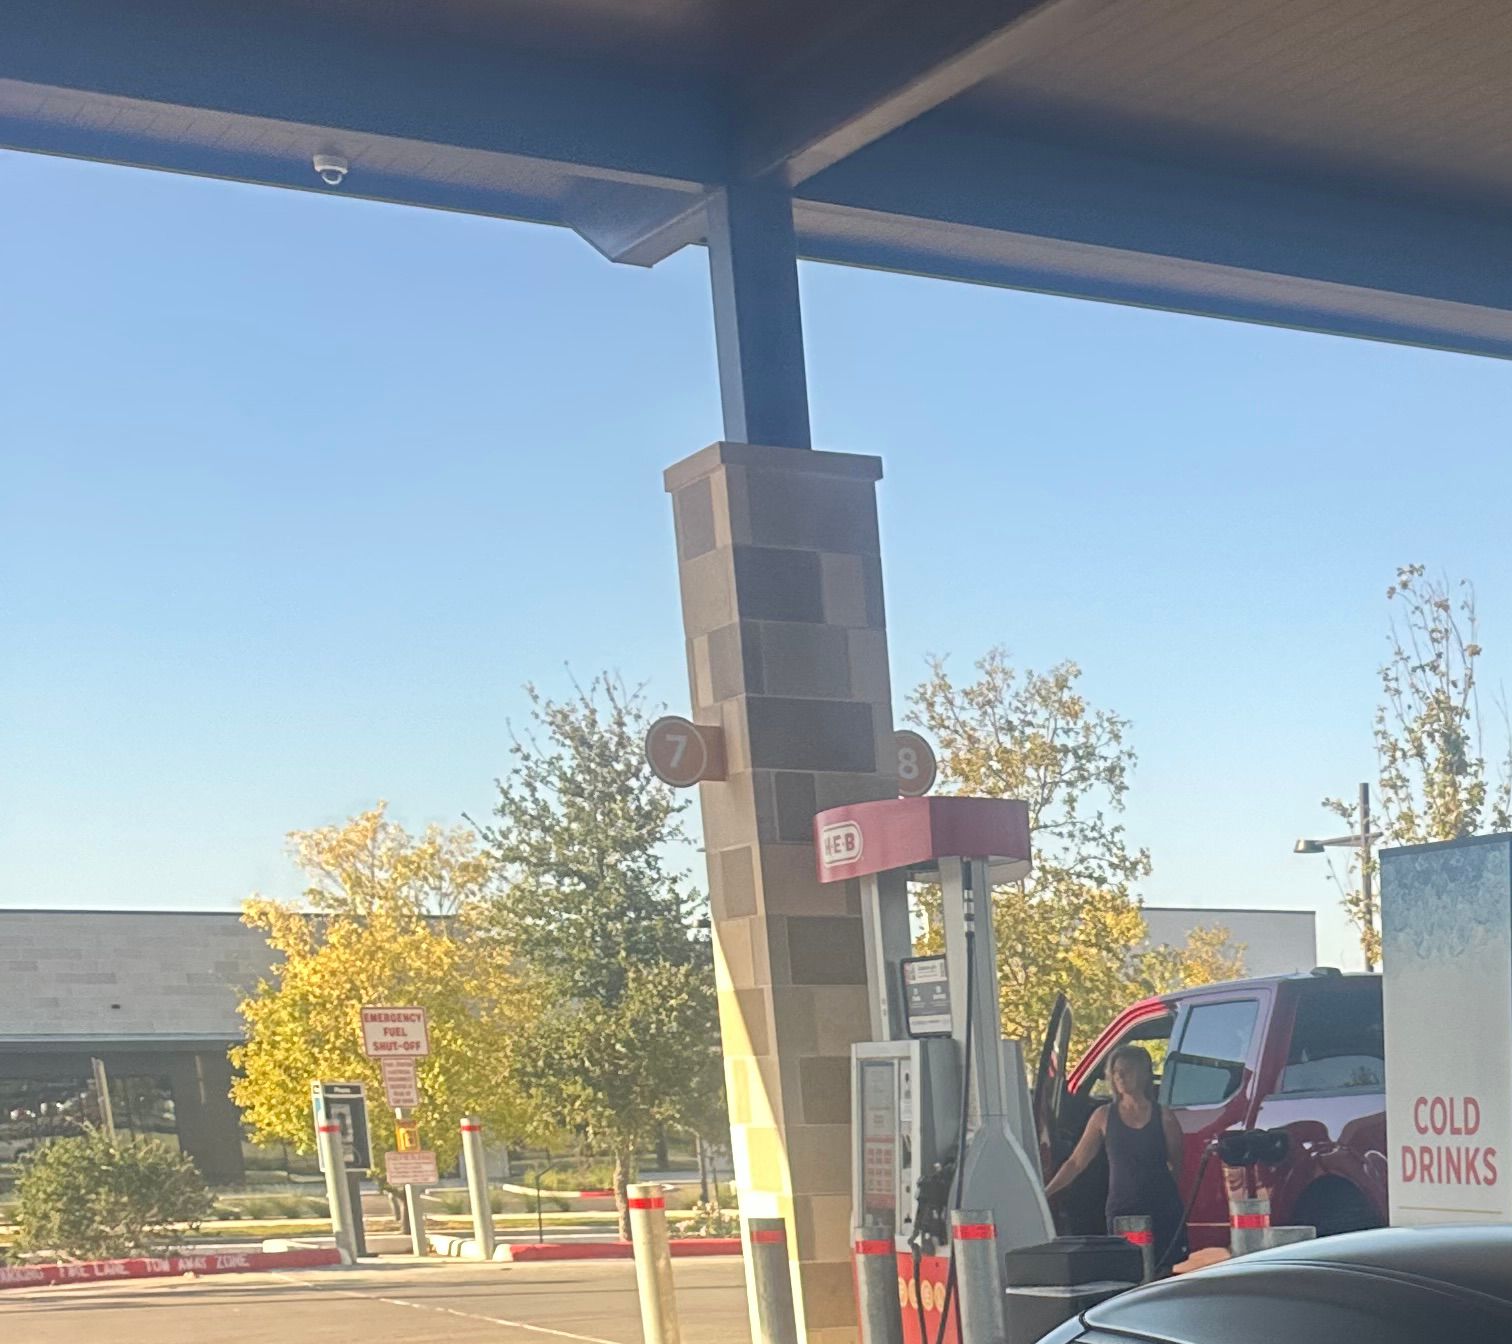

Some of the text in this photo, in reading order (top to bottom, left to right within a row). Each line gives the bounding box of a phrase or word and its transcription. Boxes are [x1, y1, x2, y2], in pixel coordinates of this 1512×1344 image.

[665, 733, 688, 769] 7
[898, 747, 919, 780] 8
[363, 1012, 421, 1023] EMERGENCY
[383, 1026, 408, 1037] FUEL
[373, 1041, 421, 1051] SHUT-OFF
[1414, 1096, 1481, 1136] COLD
[1401, 1145, 1498, 1186] DRINKS
[215, 1253, 251, 1270] ZONE
